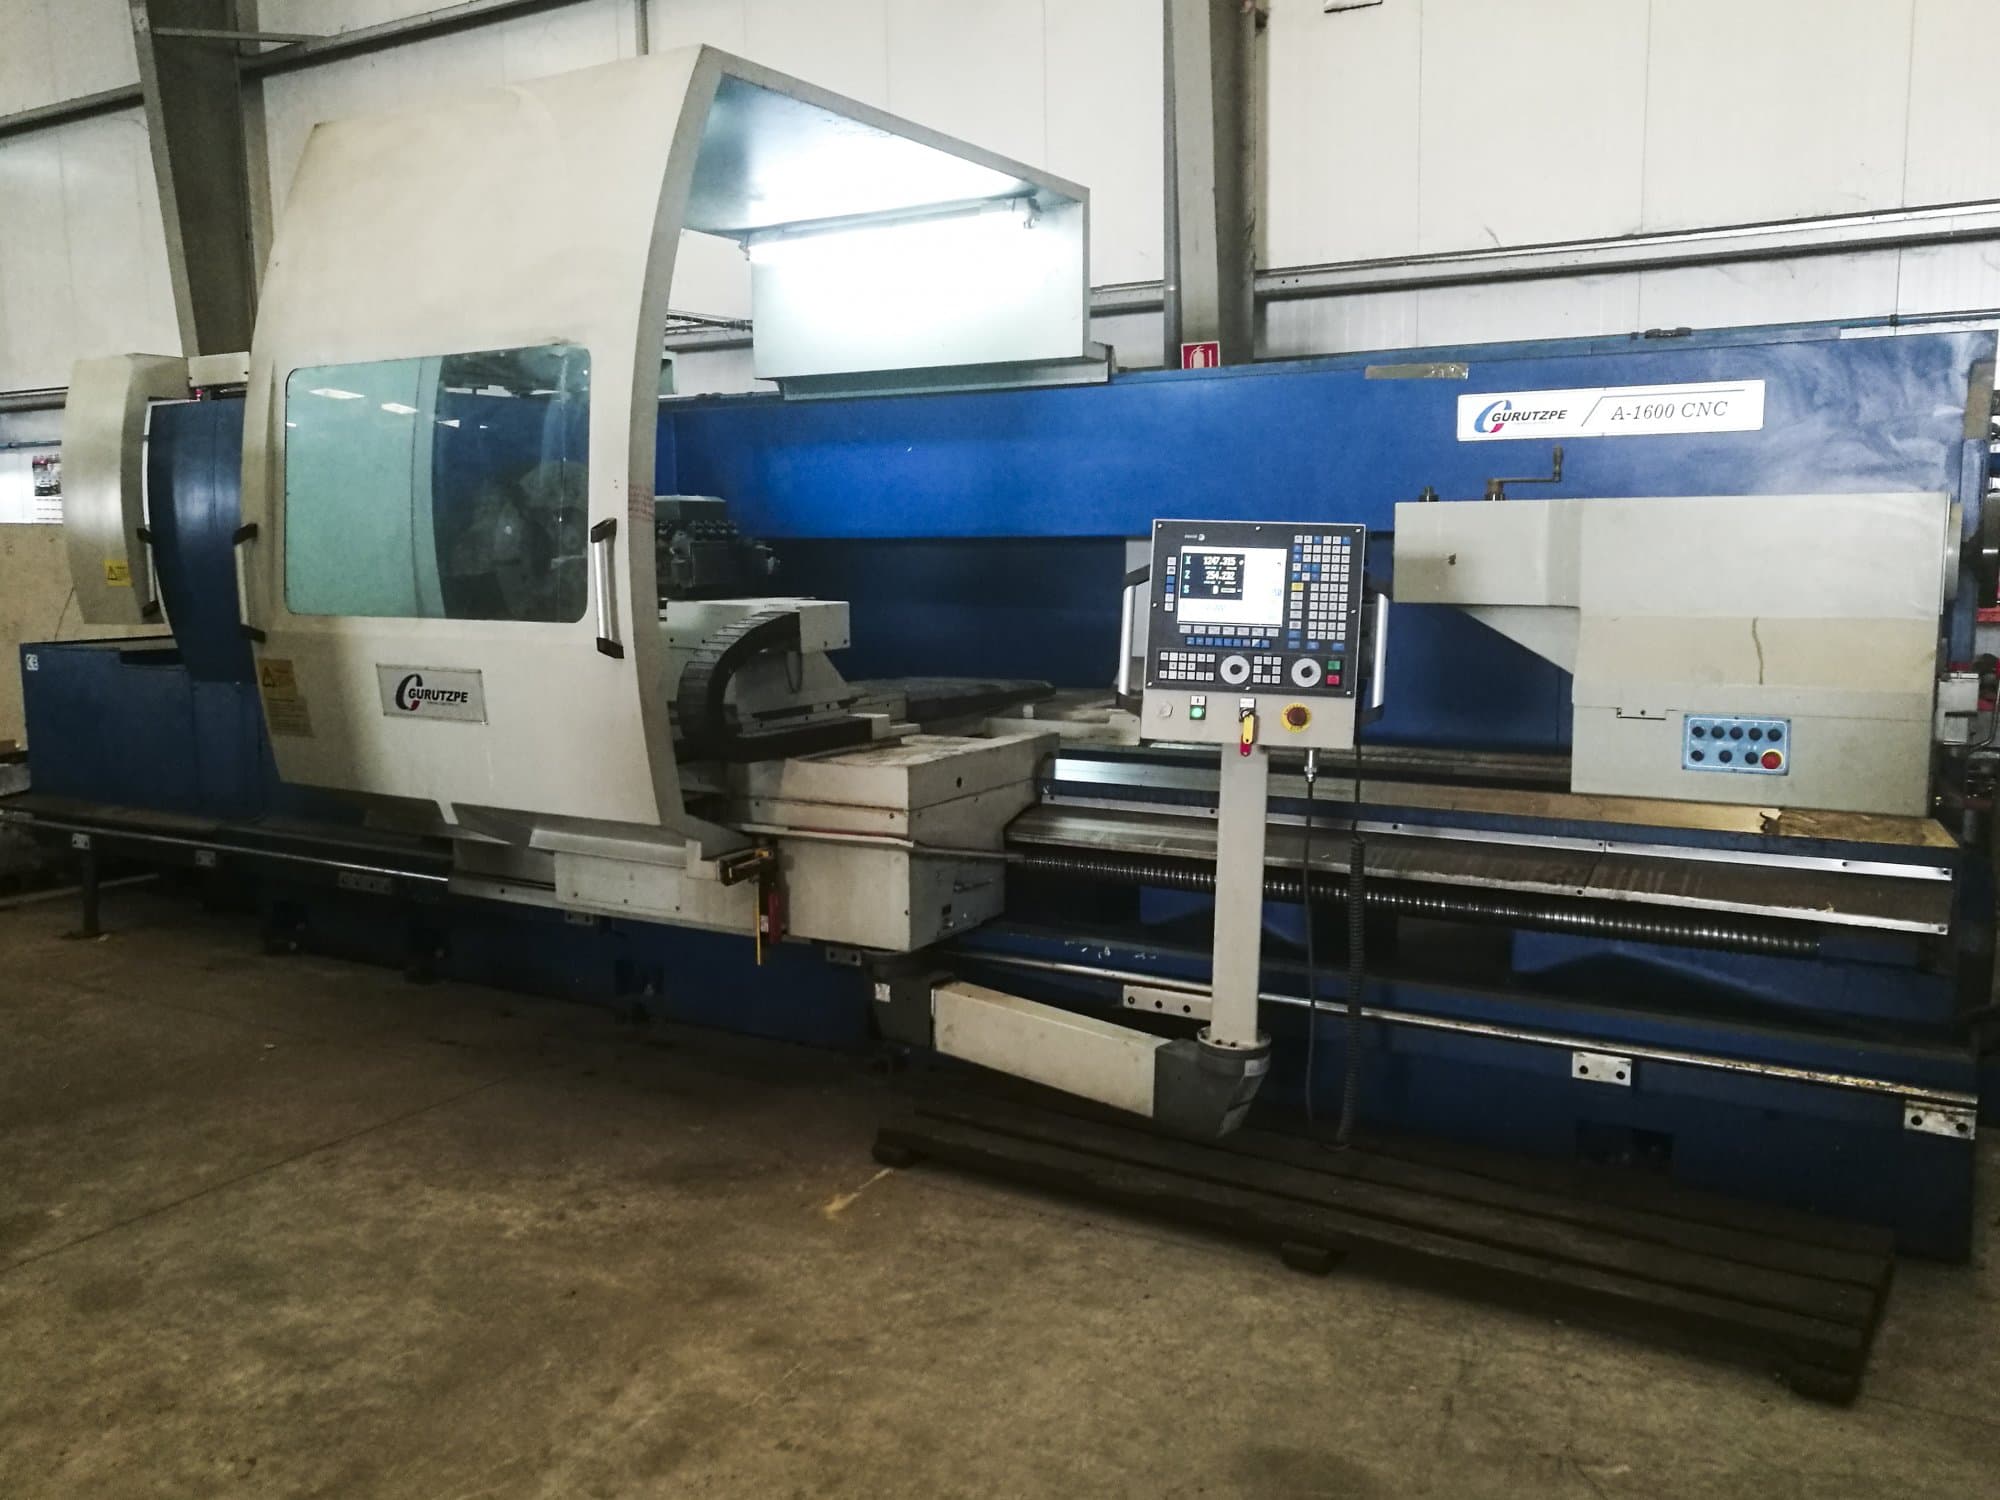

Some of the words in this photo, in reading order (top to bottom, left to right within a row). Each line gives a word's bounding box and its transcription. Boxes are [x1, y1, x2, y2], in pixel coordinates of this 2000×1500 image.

[1491, 410, 1568, 422] GURUTZPE
[1610, 403, 1675, 420] A-1600
[1681, 401, 1728, 418] CNC
[408, 688, 469, 703] GURUTZPE
